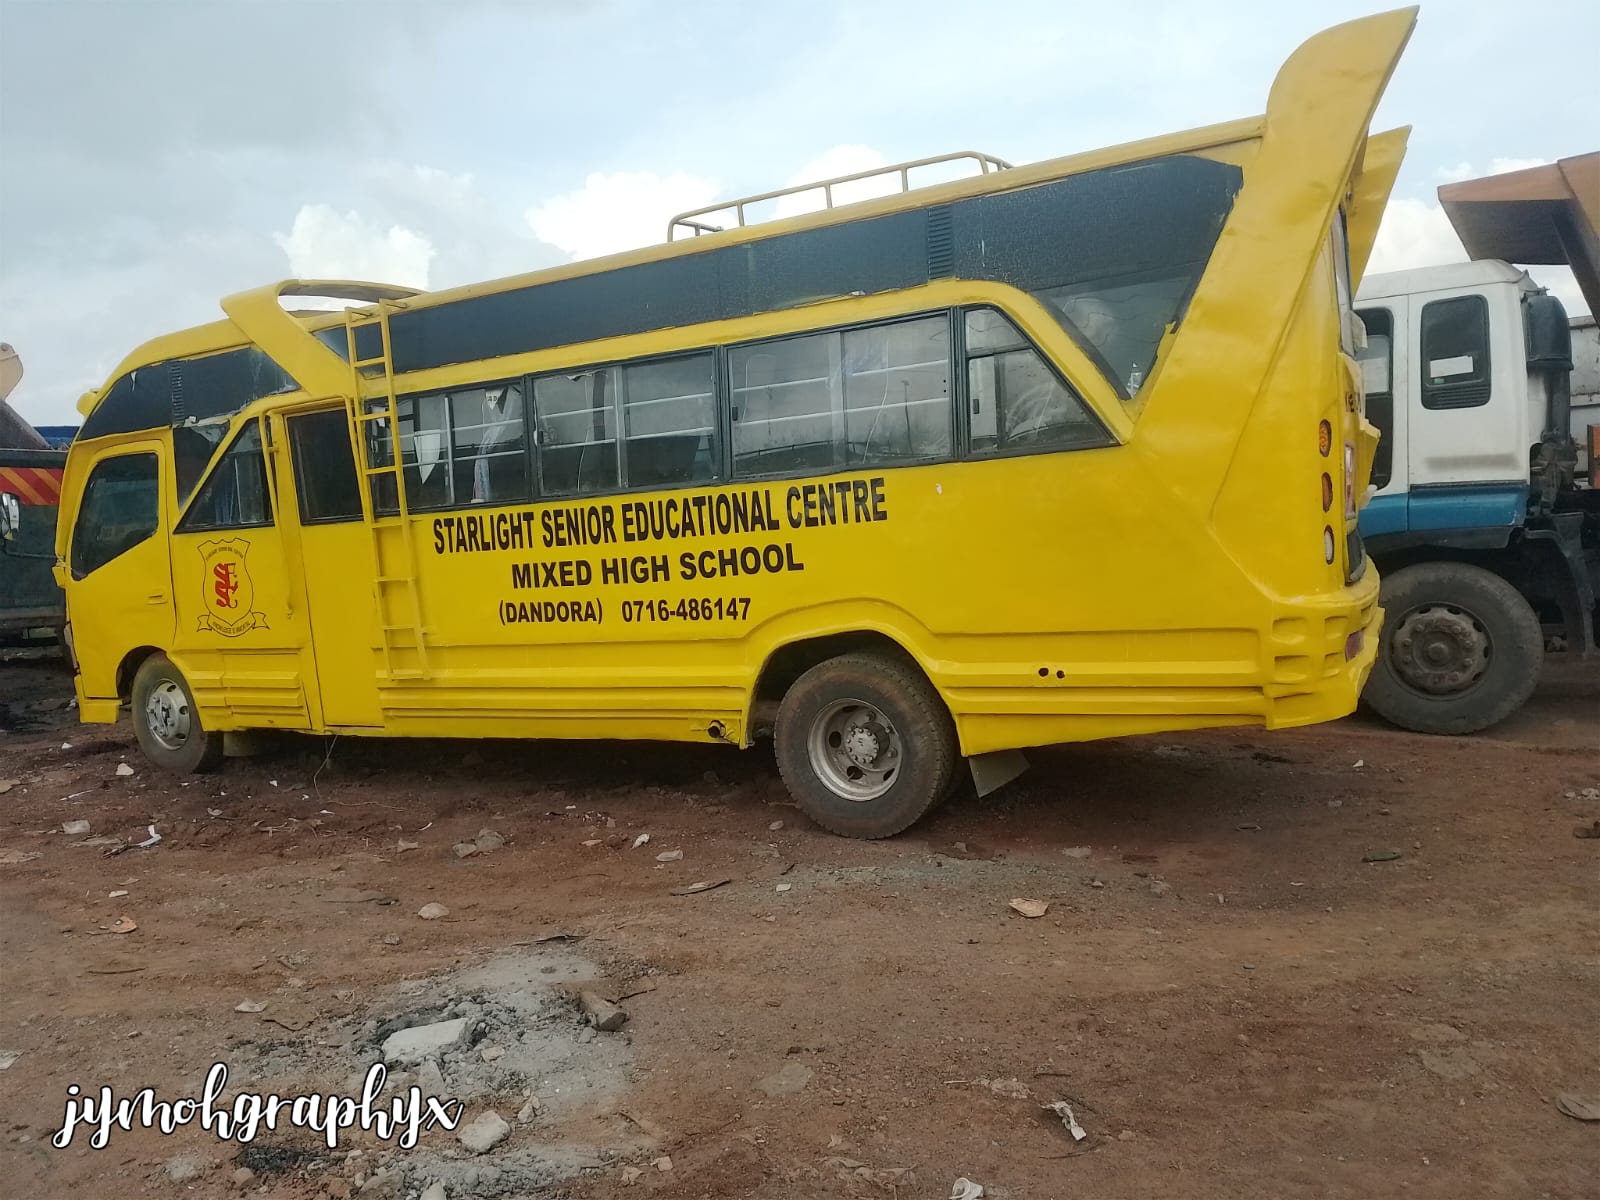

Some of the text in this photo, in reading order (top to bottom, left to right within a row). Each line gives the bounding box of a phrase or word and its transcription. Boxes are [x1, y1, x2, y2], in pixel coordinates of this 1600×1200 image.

[434, 477, 888, 554] STARLIGHT SENIOR EDUCATIONAL CENTRE
[511, 542, 805, 589] MIXED HIGH SCHOOL
[498, 597, 751, 627] (DANDORA) 0716-486147
